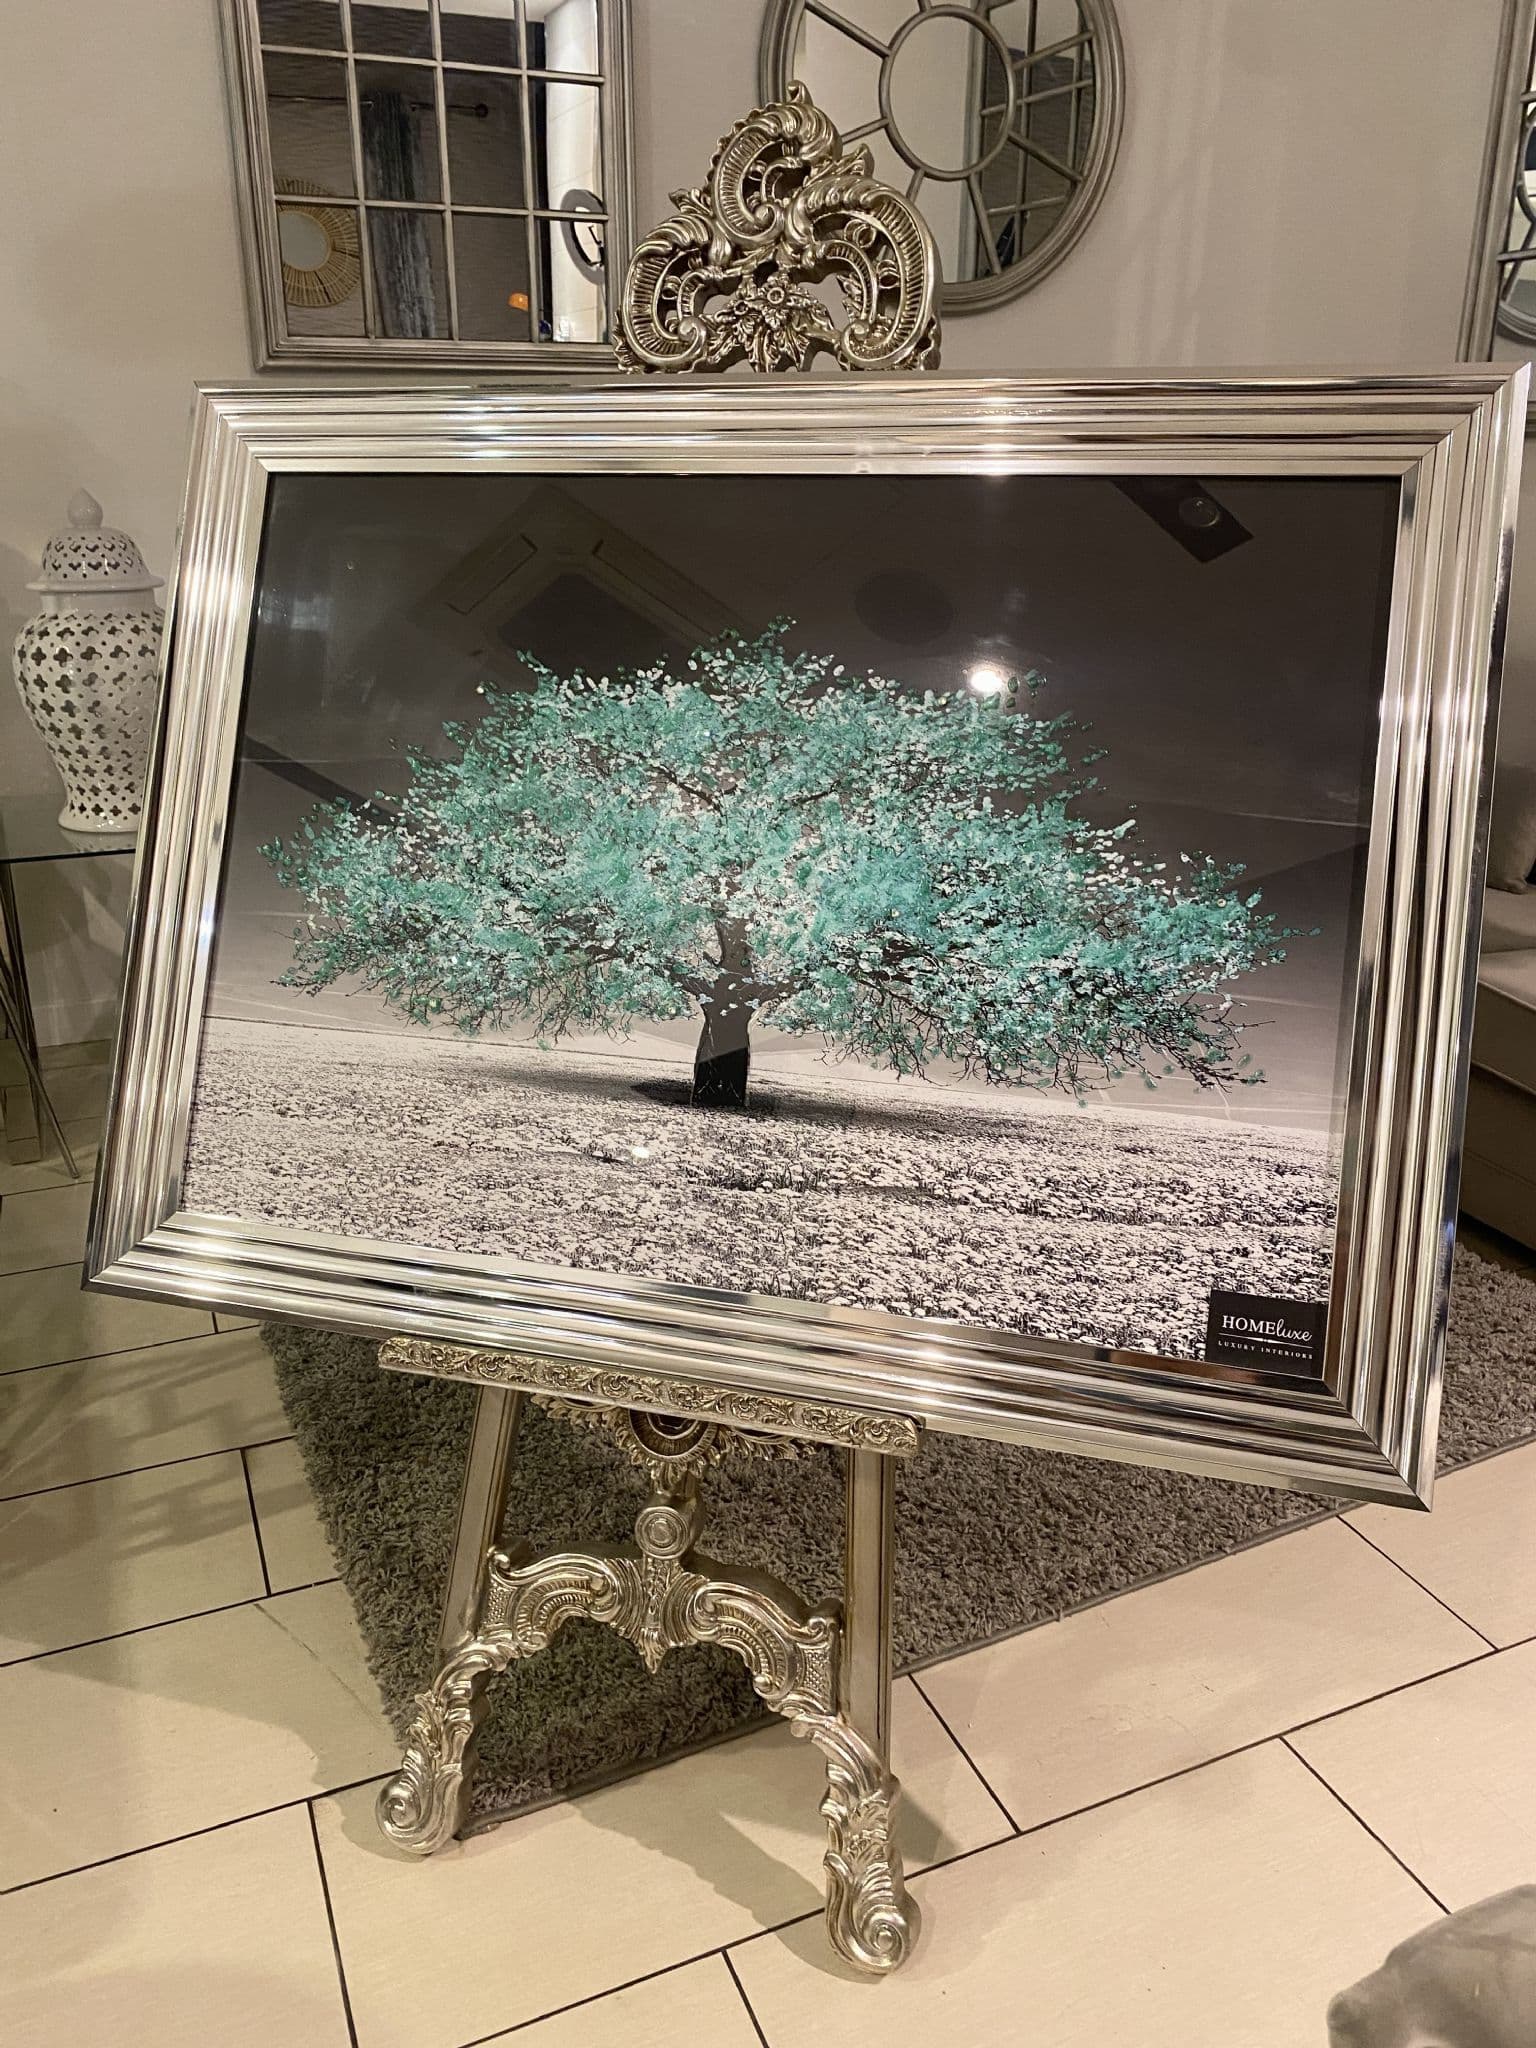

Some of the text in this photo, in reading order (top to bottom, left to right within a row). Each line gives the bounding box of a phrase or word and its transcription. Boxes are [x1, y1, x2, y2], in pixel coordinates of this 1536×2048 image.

[1221, 1314, 1313, 1342] HOMEluxe
[1218, 1340, 1313, 1360] LUXURY INTERIORS
